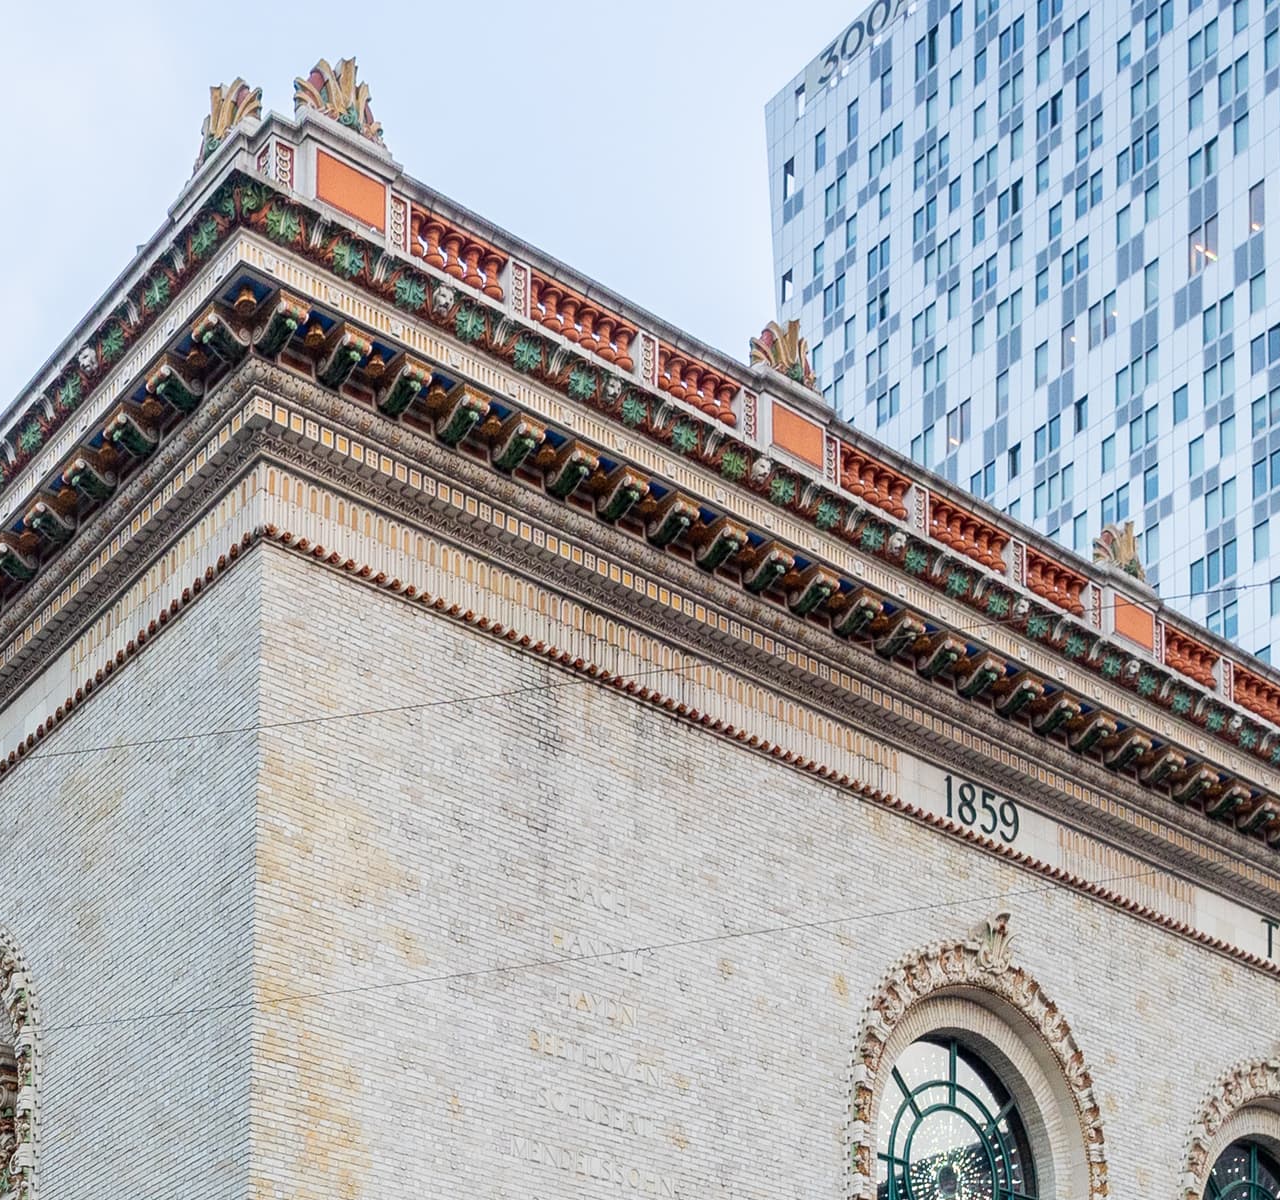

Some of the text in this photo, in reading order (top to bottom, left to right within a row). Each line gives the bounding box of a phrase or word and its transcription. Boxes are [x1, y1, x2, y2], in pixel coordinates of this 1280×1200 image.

[944, 774, 1020, 843] 1859
[537, 1087, 654, 1139] SCHUBERT
[511, 1137, 674, 1199] MENDELSSOHN
